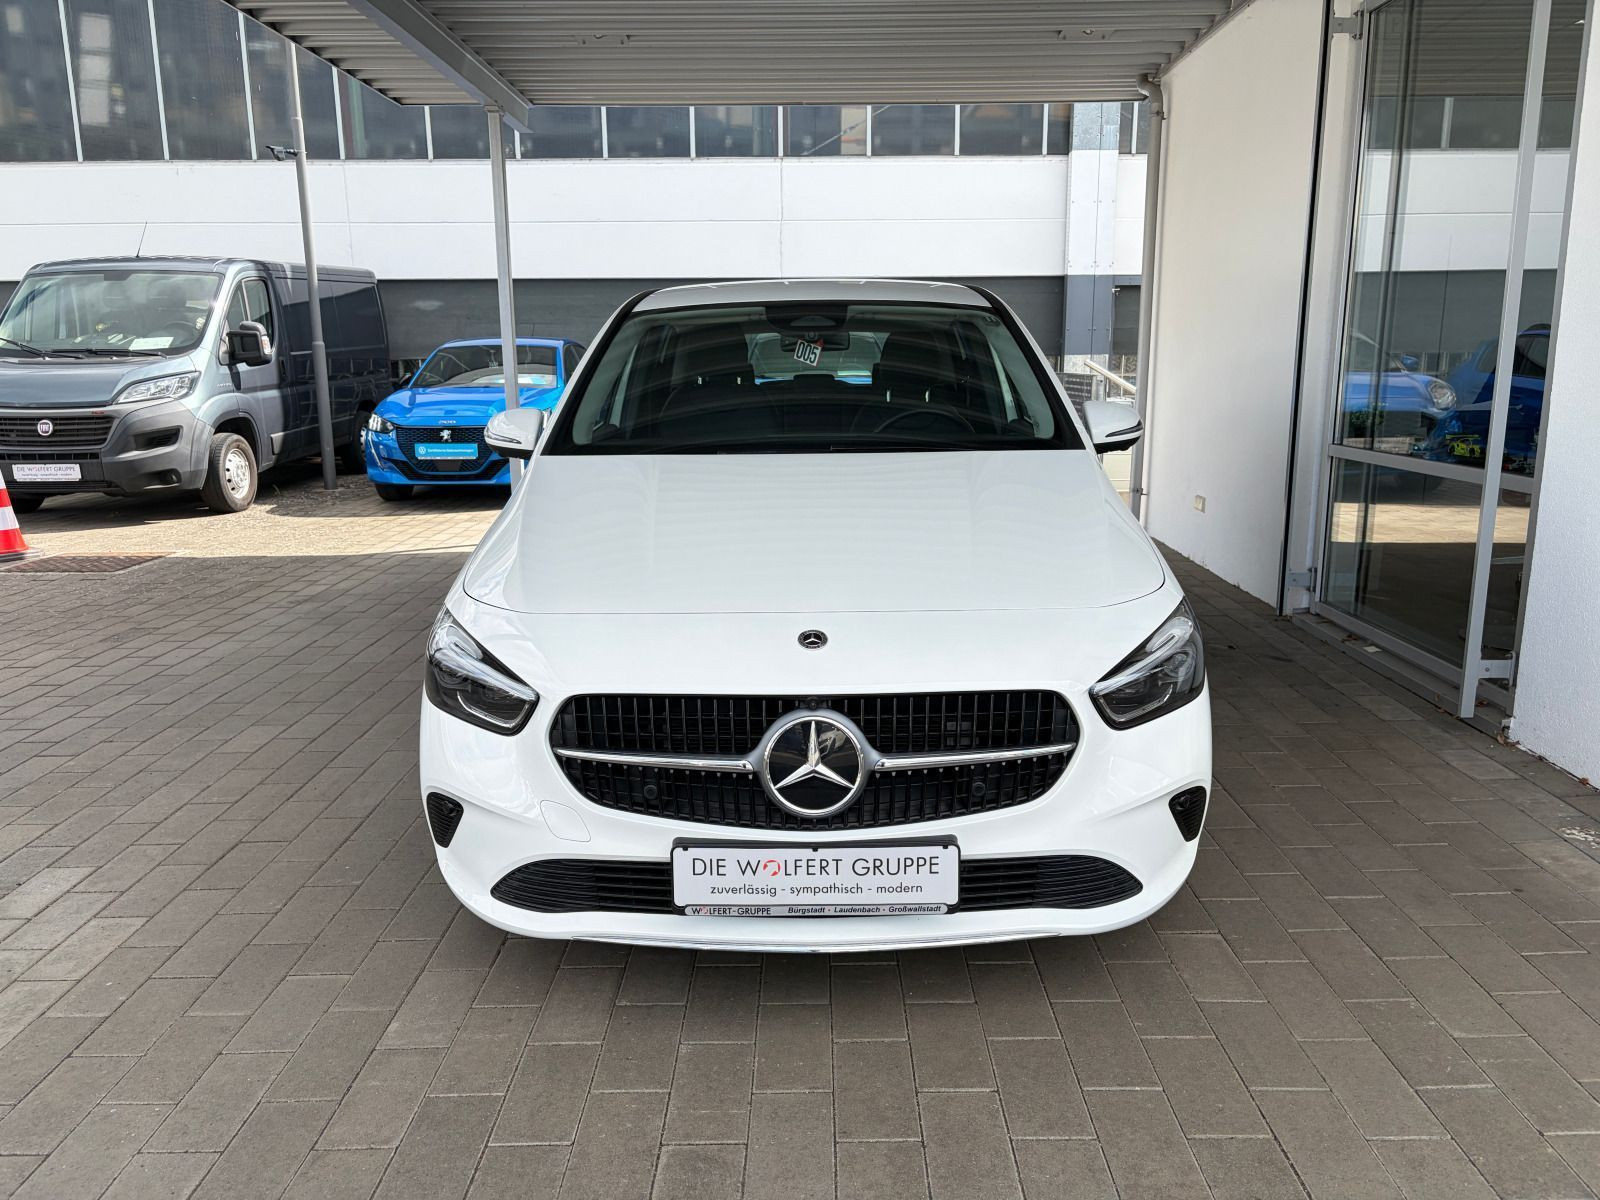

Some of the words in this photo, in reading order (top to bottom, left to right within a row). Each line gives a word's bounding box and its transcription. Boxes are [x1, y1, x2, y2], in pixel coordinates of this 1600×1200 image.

[796, 341, 819, 364] 005
[692, 858, 727, 876] DIE
[737, 858, 843, 876] WOLFERT
[852, 856, 940, 876] GRUPPE
[710, 883, 777, 897] zuverlässig
[790, 883, 863, 896] sympathisch
[876, 882, 923, 894] modern
[788, 905, 826, 914] Bürgstadt
[834, 905, 881, 914] Laudenbach
[888, 905, 942, 914] Großwallstadt
